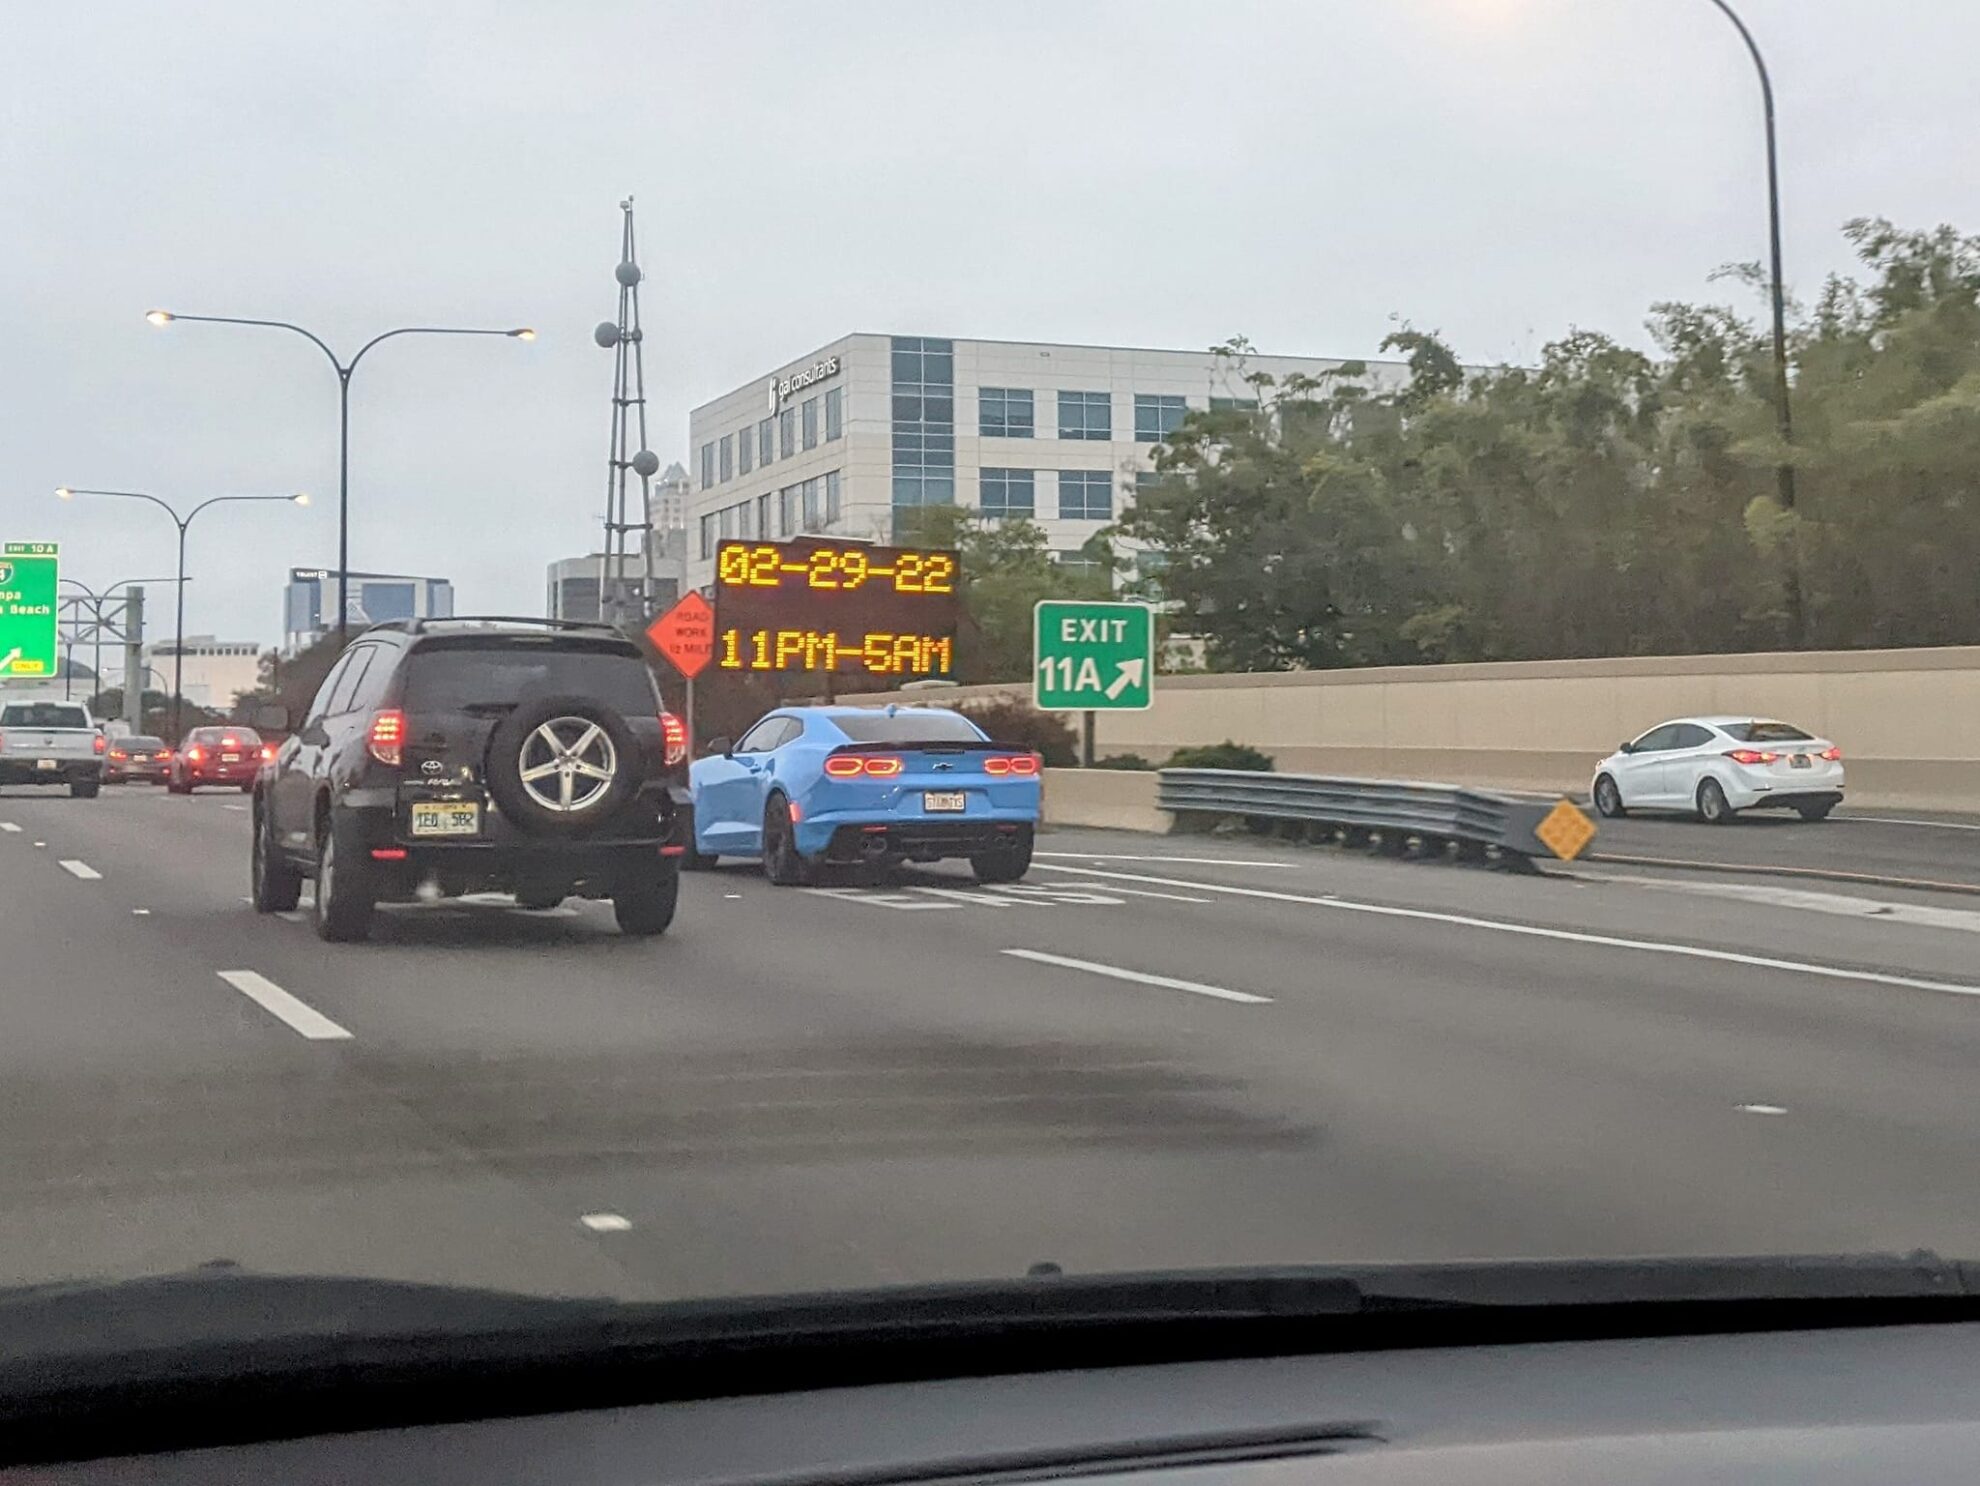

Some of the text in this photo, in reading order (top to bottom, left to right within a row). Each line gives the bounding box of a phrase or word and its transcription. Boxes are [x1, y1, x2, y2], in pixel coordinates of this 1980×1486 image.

[791, 358, 837, 392] consultants
[719, 545, 953, 593] 02-29-22
[10, 603, 51, 615] Beach
[1061, 618, 1128, 643] EXIT
[720, 629, 951, 674] 11PM-5AM
[1040, 656, 1102, 692] 11A
